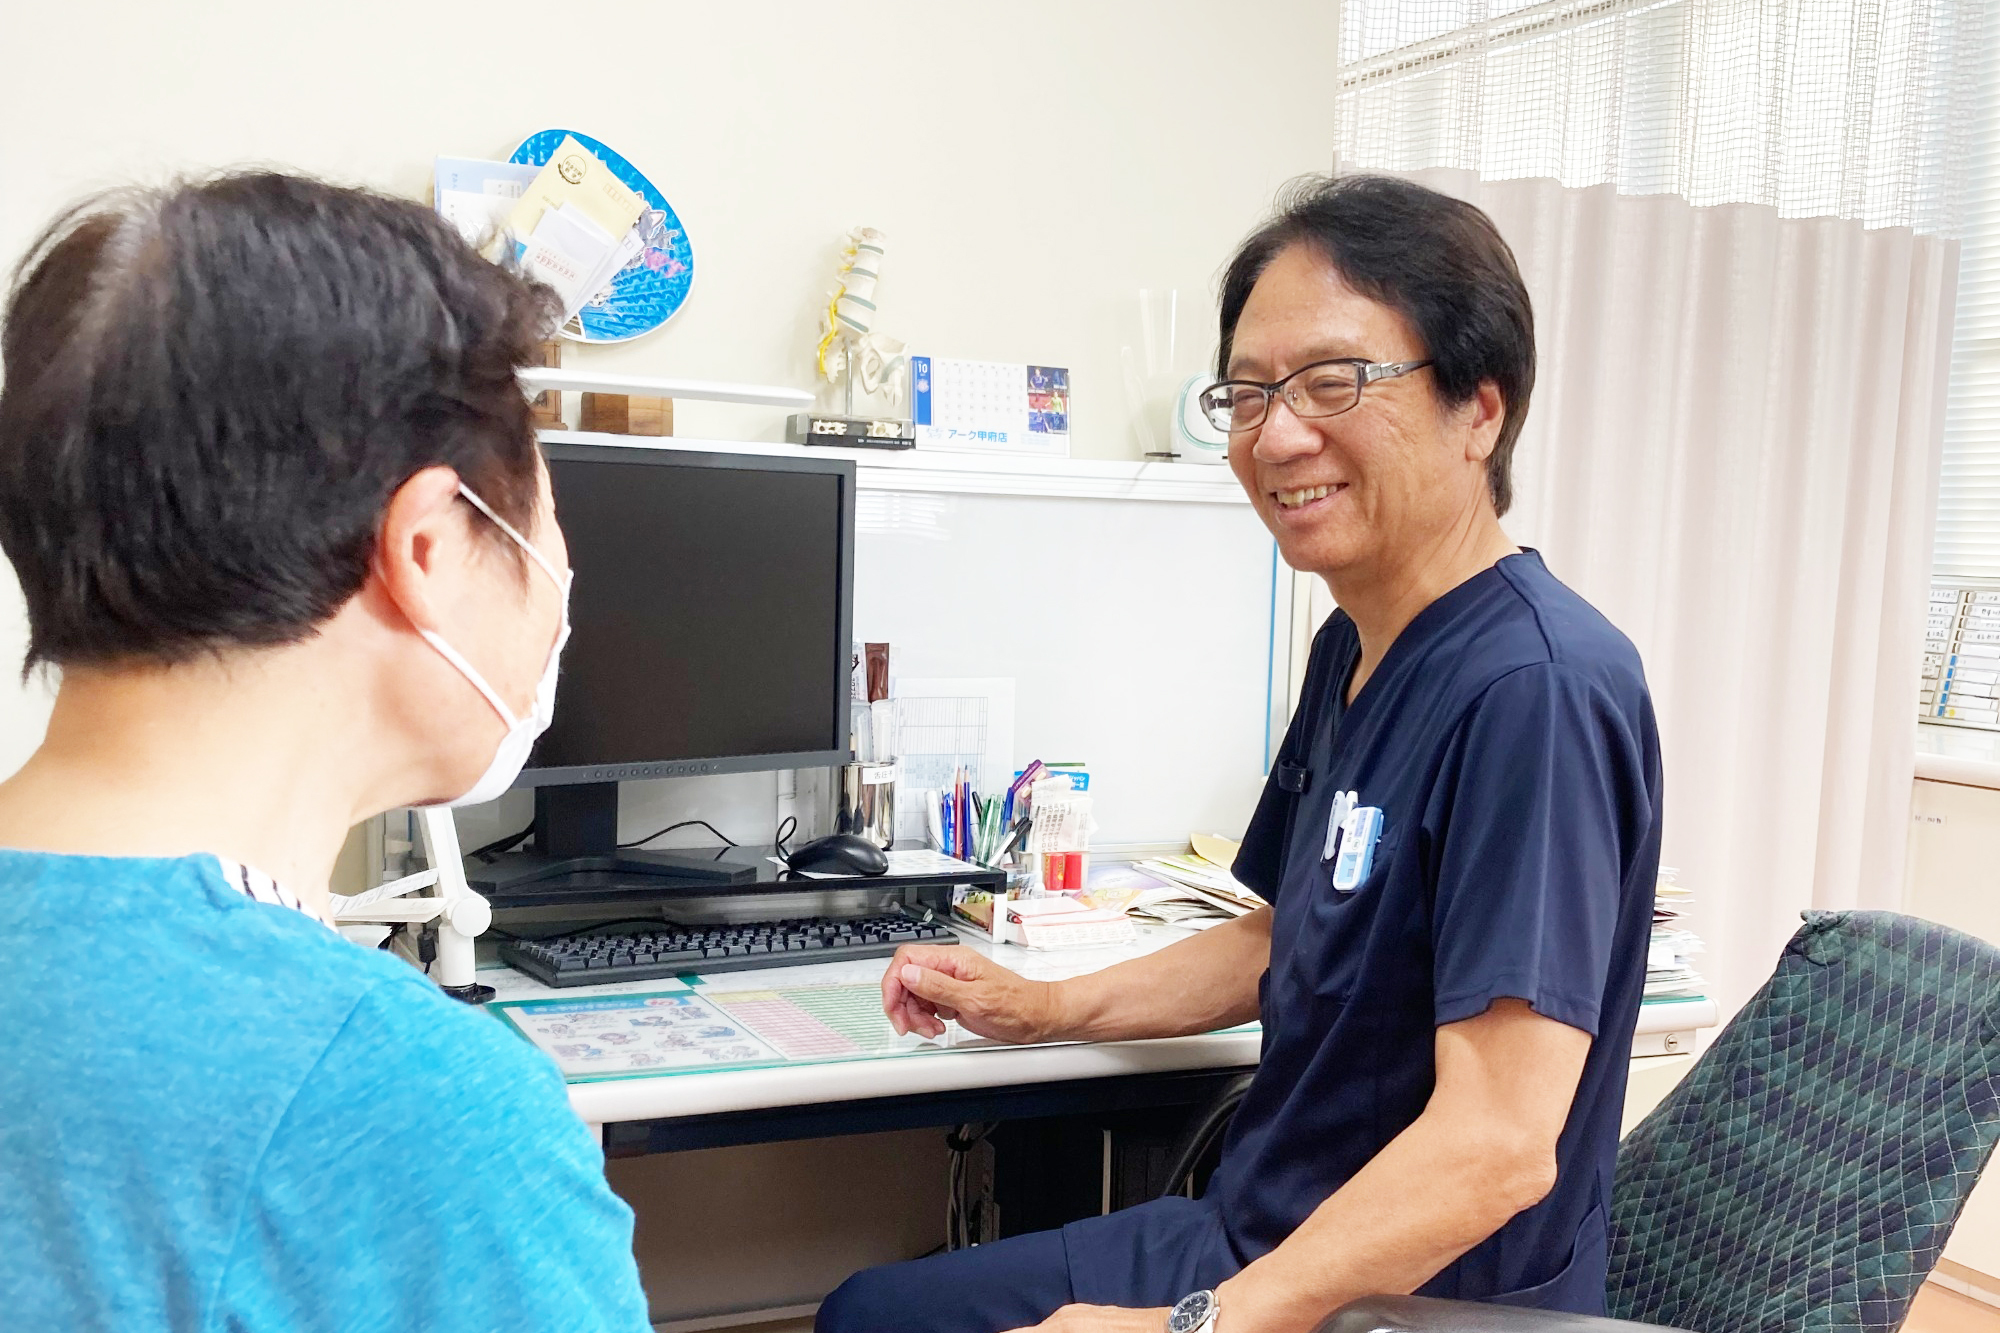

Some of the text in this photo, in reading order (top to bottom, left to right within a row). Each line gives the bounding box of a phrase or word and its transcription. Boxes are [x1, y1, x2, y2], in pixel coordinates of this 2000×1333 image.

[918, 363, 928, 374] 10
[948, 429, 1008, 443] アーク甲府店
